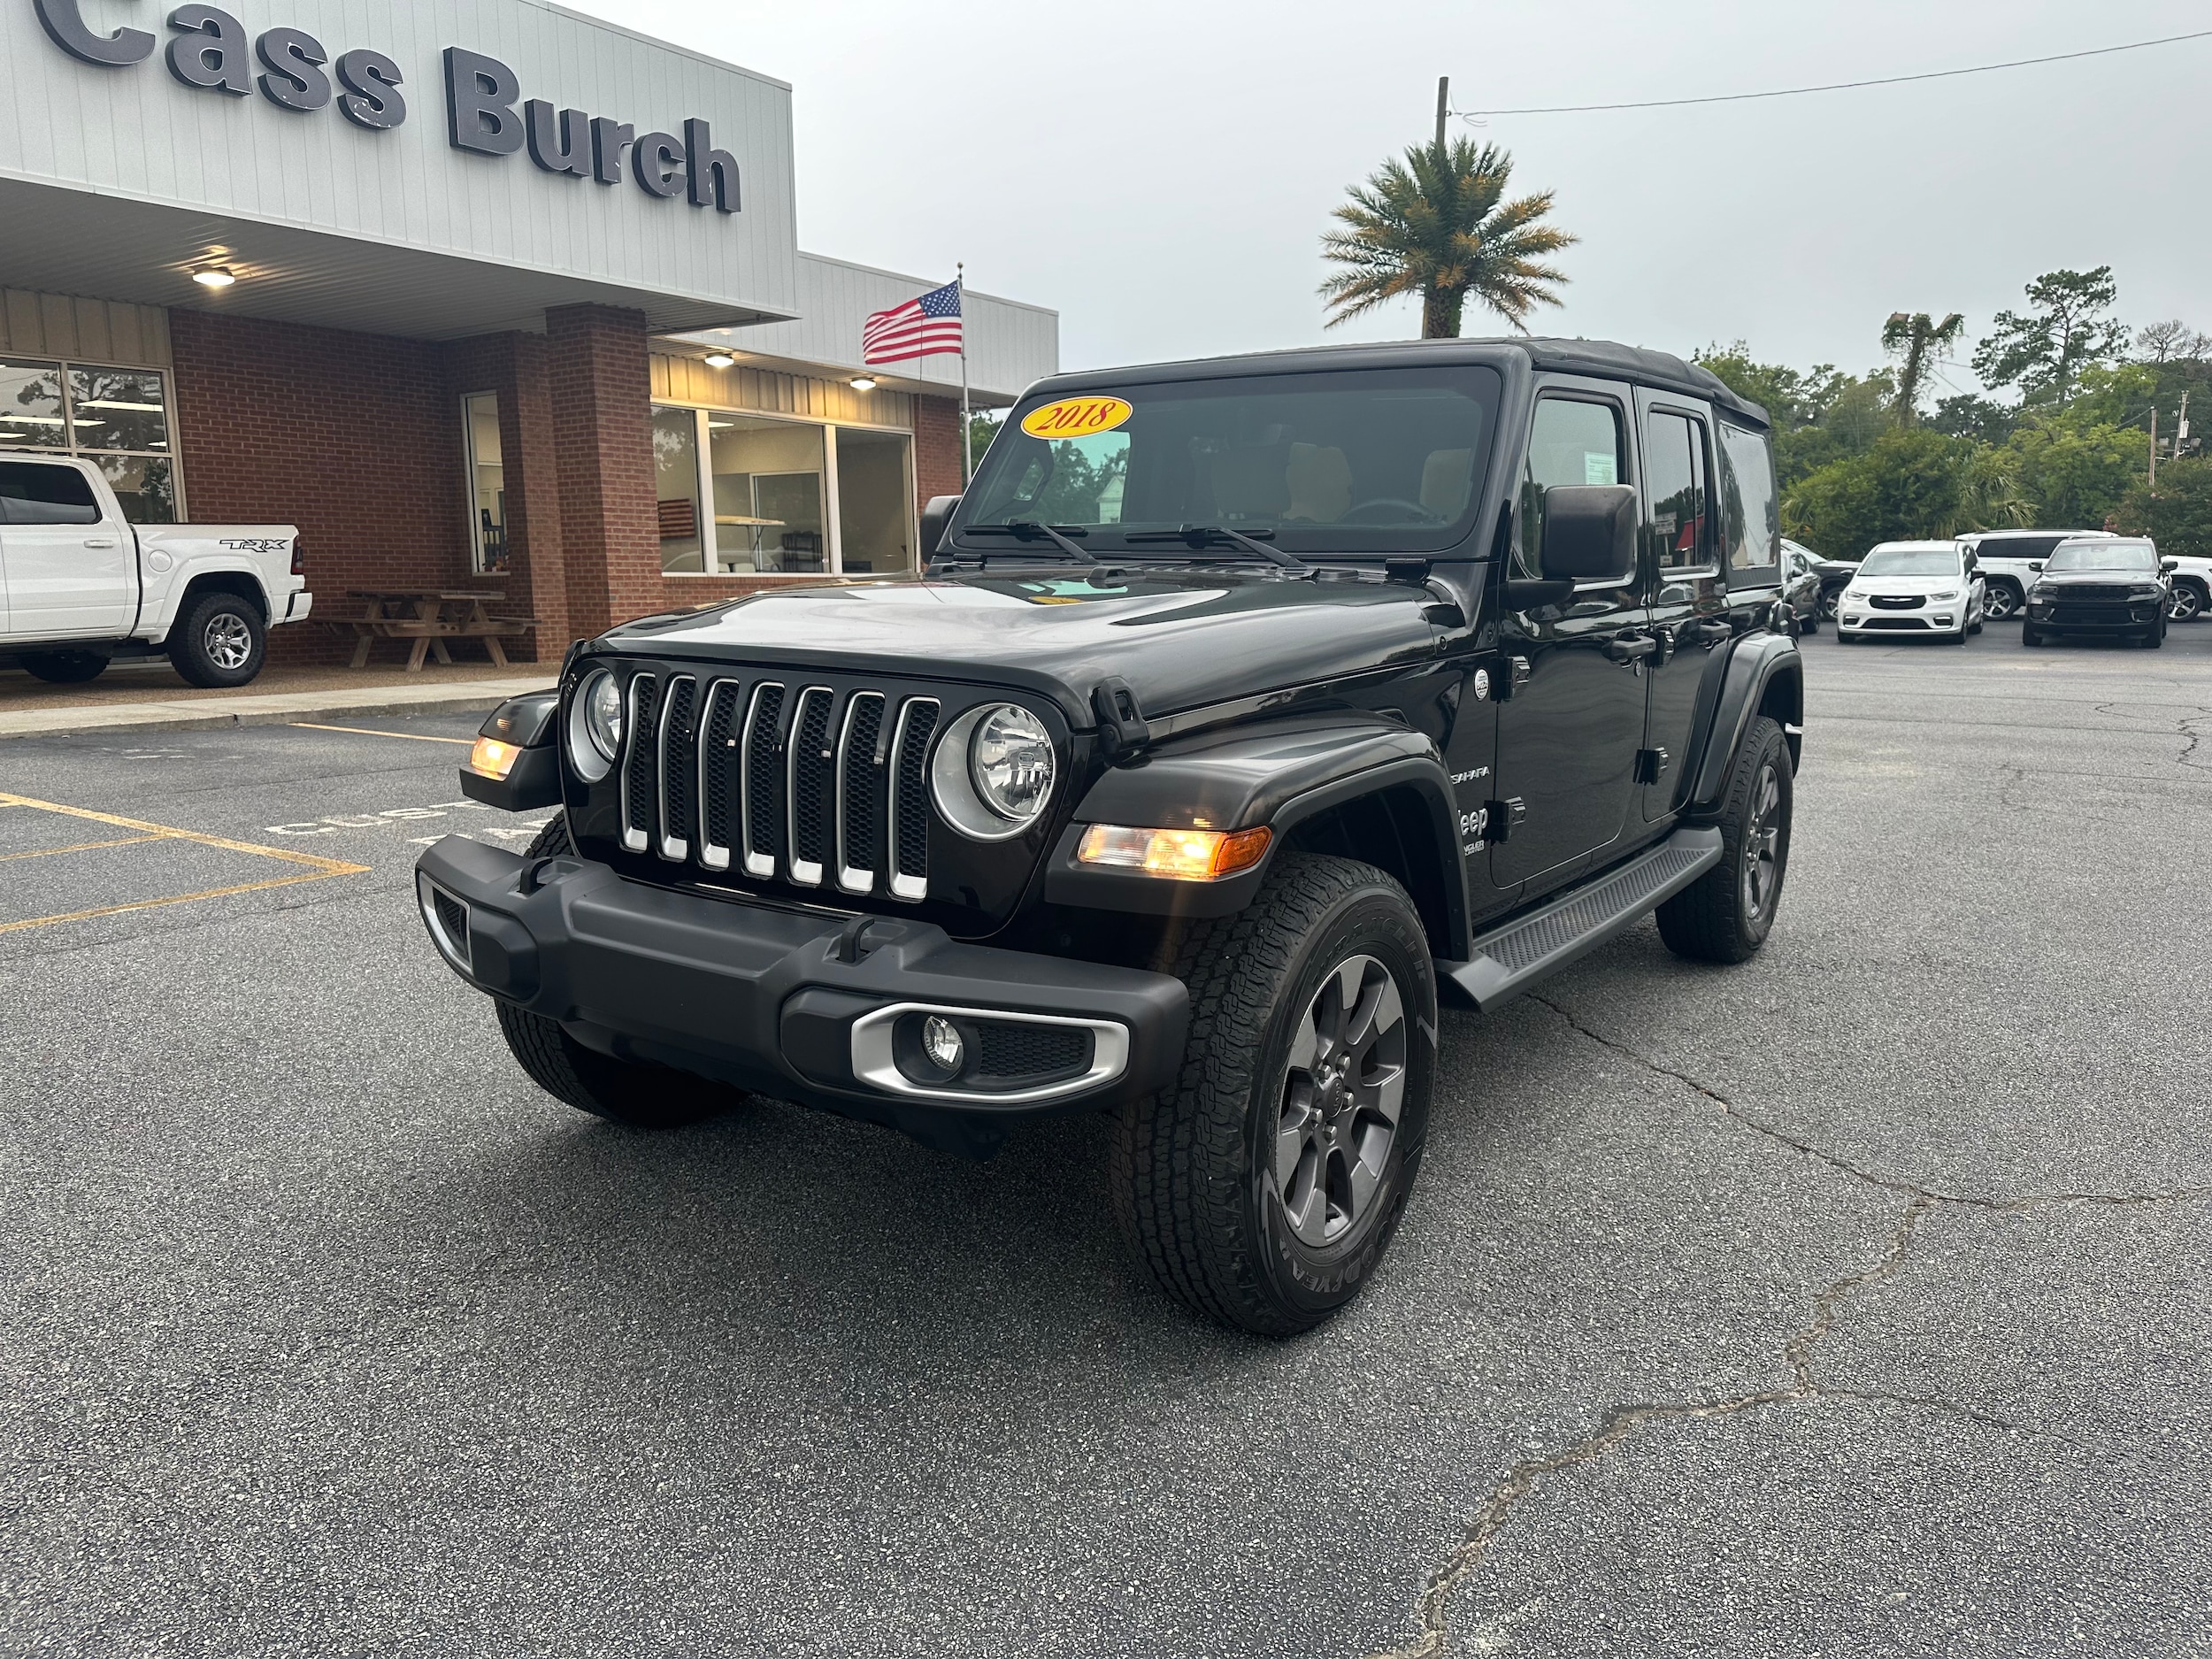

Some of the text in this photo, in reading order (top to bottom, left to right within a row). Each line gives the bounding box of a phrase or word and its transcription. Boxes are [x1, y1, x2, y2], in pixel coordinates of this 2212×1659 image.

[33, 0, 741, 213] Cass Burch
[1034, 402, 1117, 431] 2018
[219, 539, 290, 552] TRX
[1450, 765, 1490, 785] SAHARA
[1279, 1191, 1402, 1293] GOODYEAR
